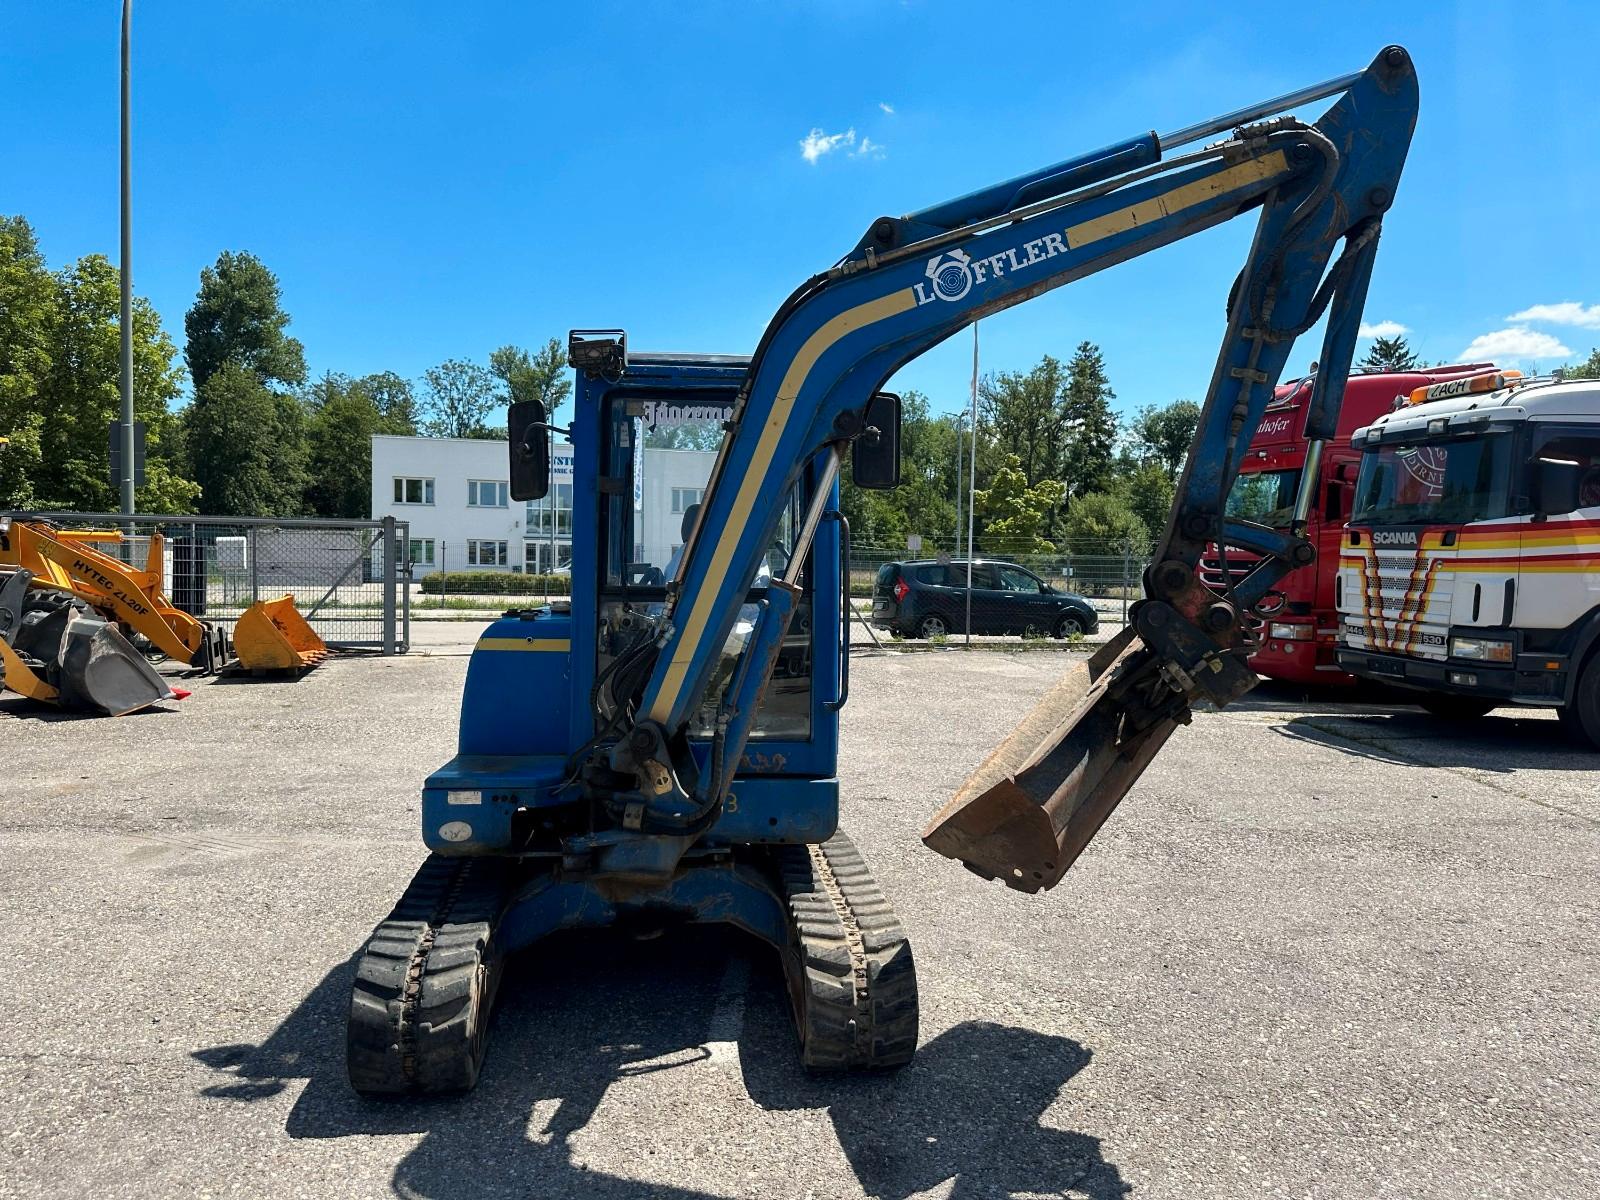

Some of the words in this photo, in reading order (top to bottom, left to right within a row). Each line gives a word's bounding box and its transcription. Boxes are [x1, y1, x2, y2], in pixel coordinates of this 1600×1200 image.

[1431, 379, 1467, 397] ZACH
[641, 401, 733, 428] Jägerme
[1373, 532, 1418, 545] SCANIA
[73, 560, 114, 590] HYTEC
[113, 589, 149, 616] ZL20F
[1423, 635, 1442, 645] 530
